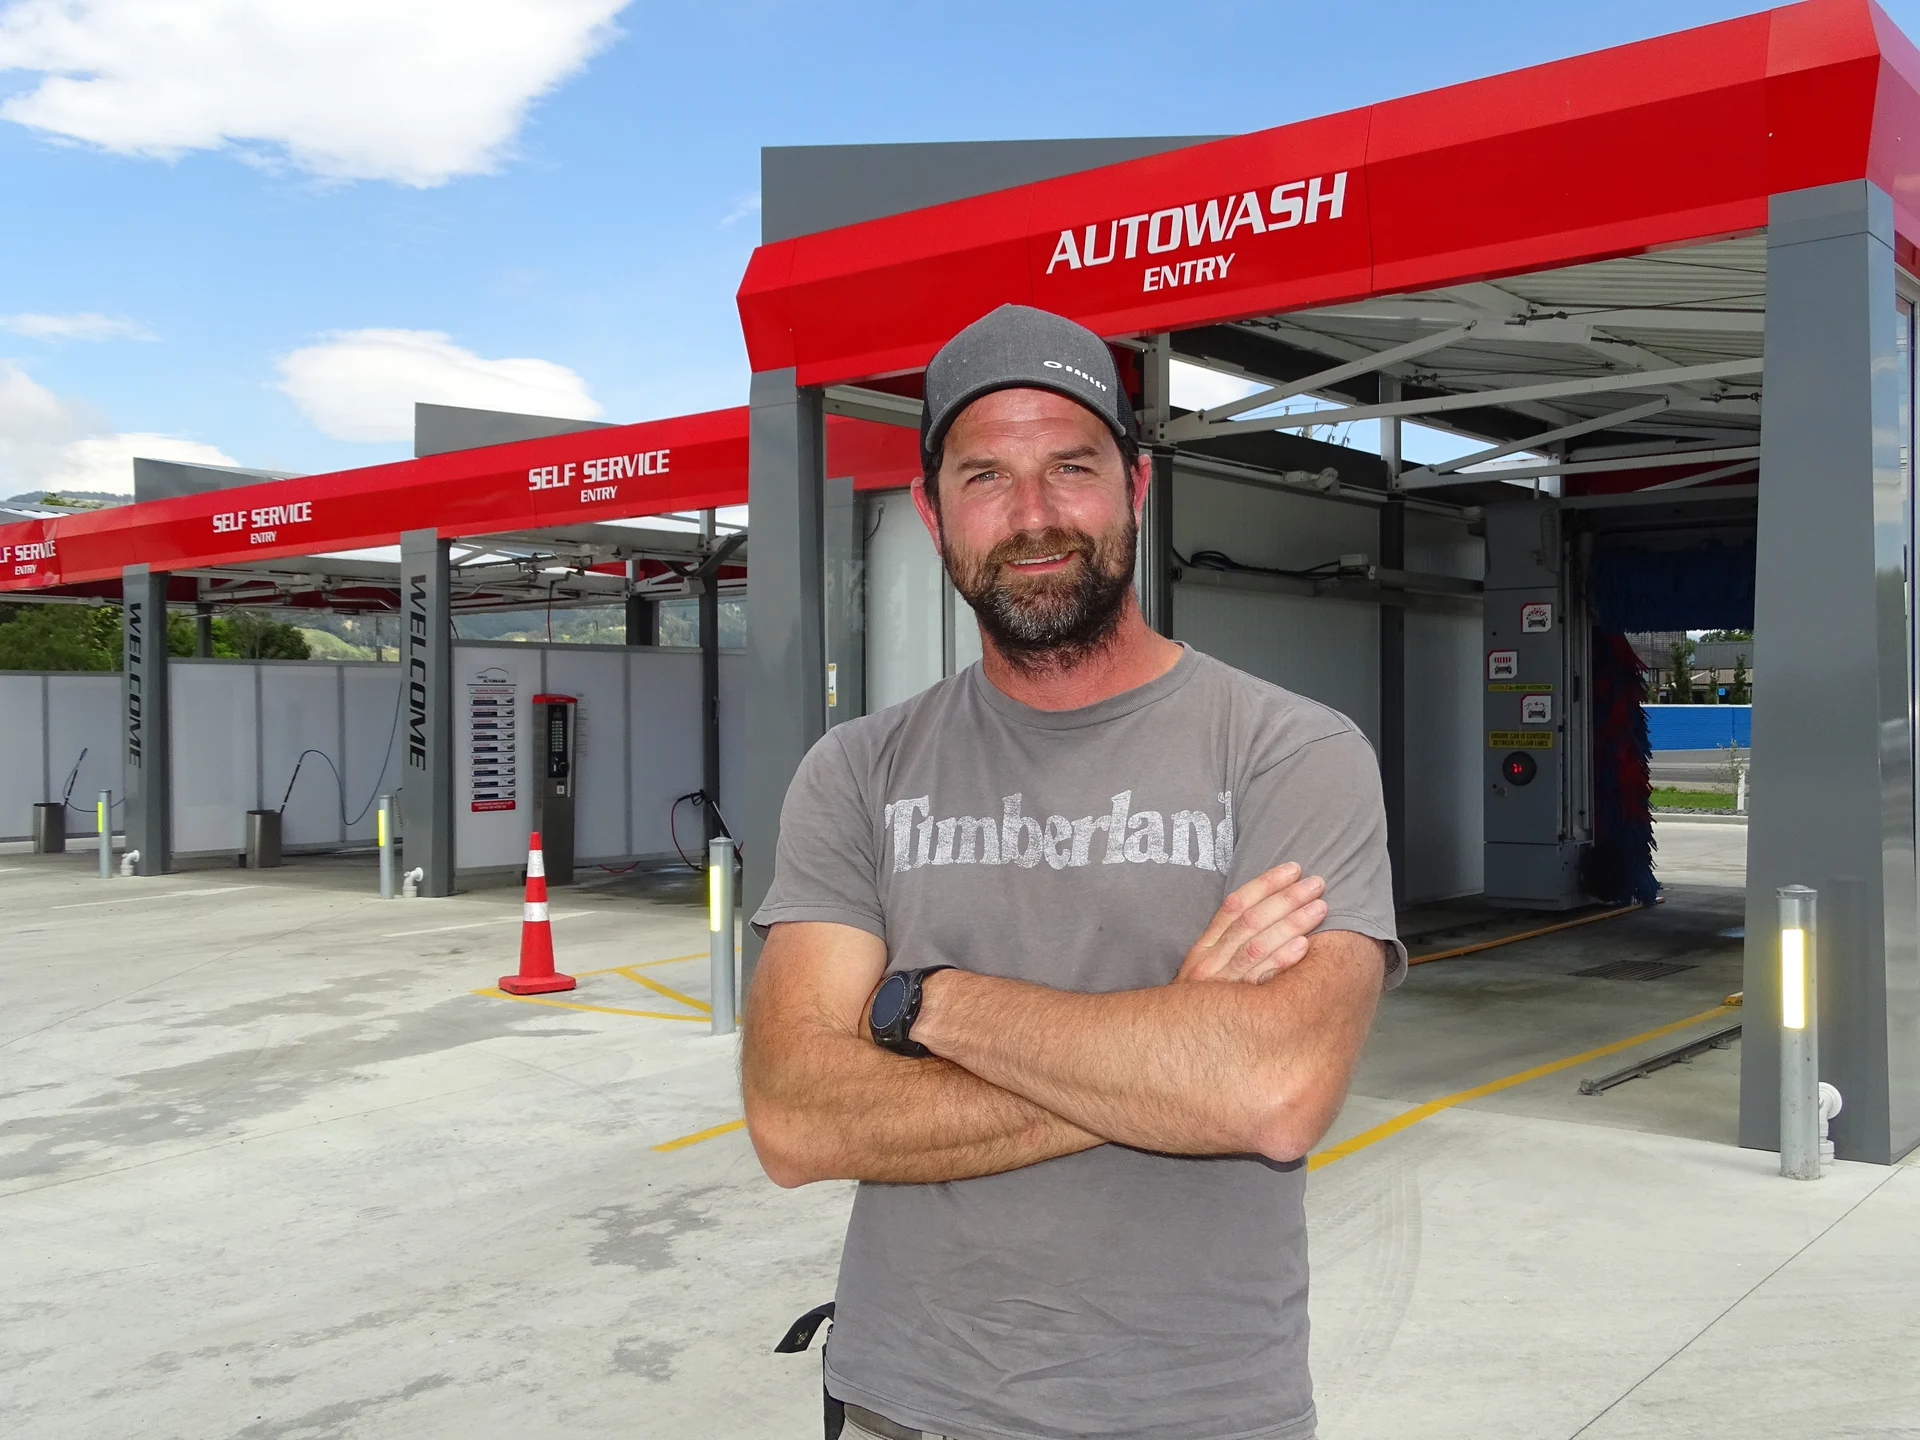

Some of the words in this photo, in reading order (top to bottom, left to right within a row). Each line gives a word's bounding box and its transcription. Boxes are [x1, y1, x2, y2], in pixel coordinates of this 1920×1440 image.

[1046, 171, 1348, 275] AUTOWASH
[1142, 252, 1236, 293] ENTRY
[528, 462, 577, 491] SELF
[583, 449, 671, 484] SERVICE
[580, 485, 618, 503] ENTRY
[212, 510, 248, 534] SELF
[250, 501, 313, 529] SERVICE
[250, 531, 278, 545] ENTRY
[0, 546, 12, 564] LF
[14, 540, 57, 562] SERVICE
[14, 564, 38, 576] ENTRY
[129, 602, 142, 769] WELCOME
[409, 574, 427, 772] WELCOME
[884, 790, 1235, 877] Timberland
